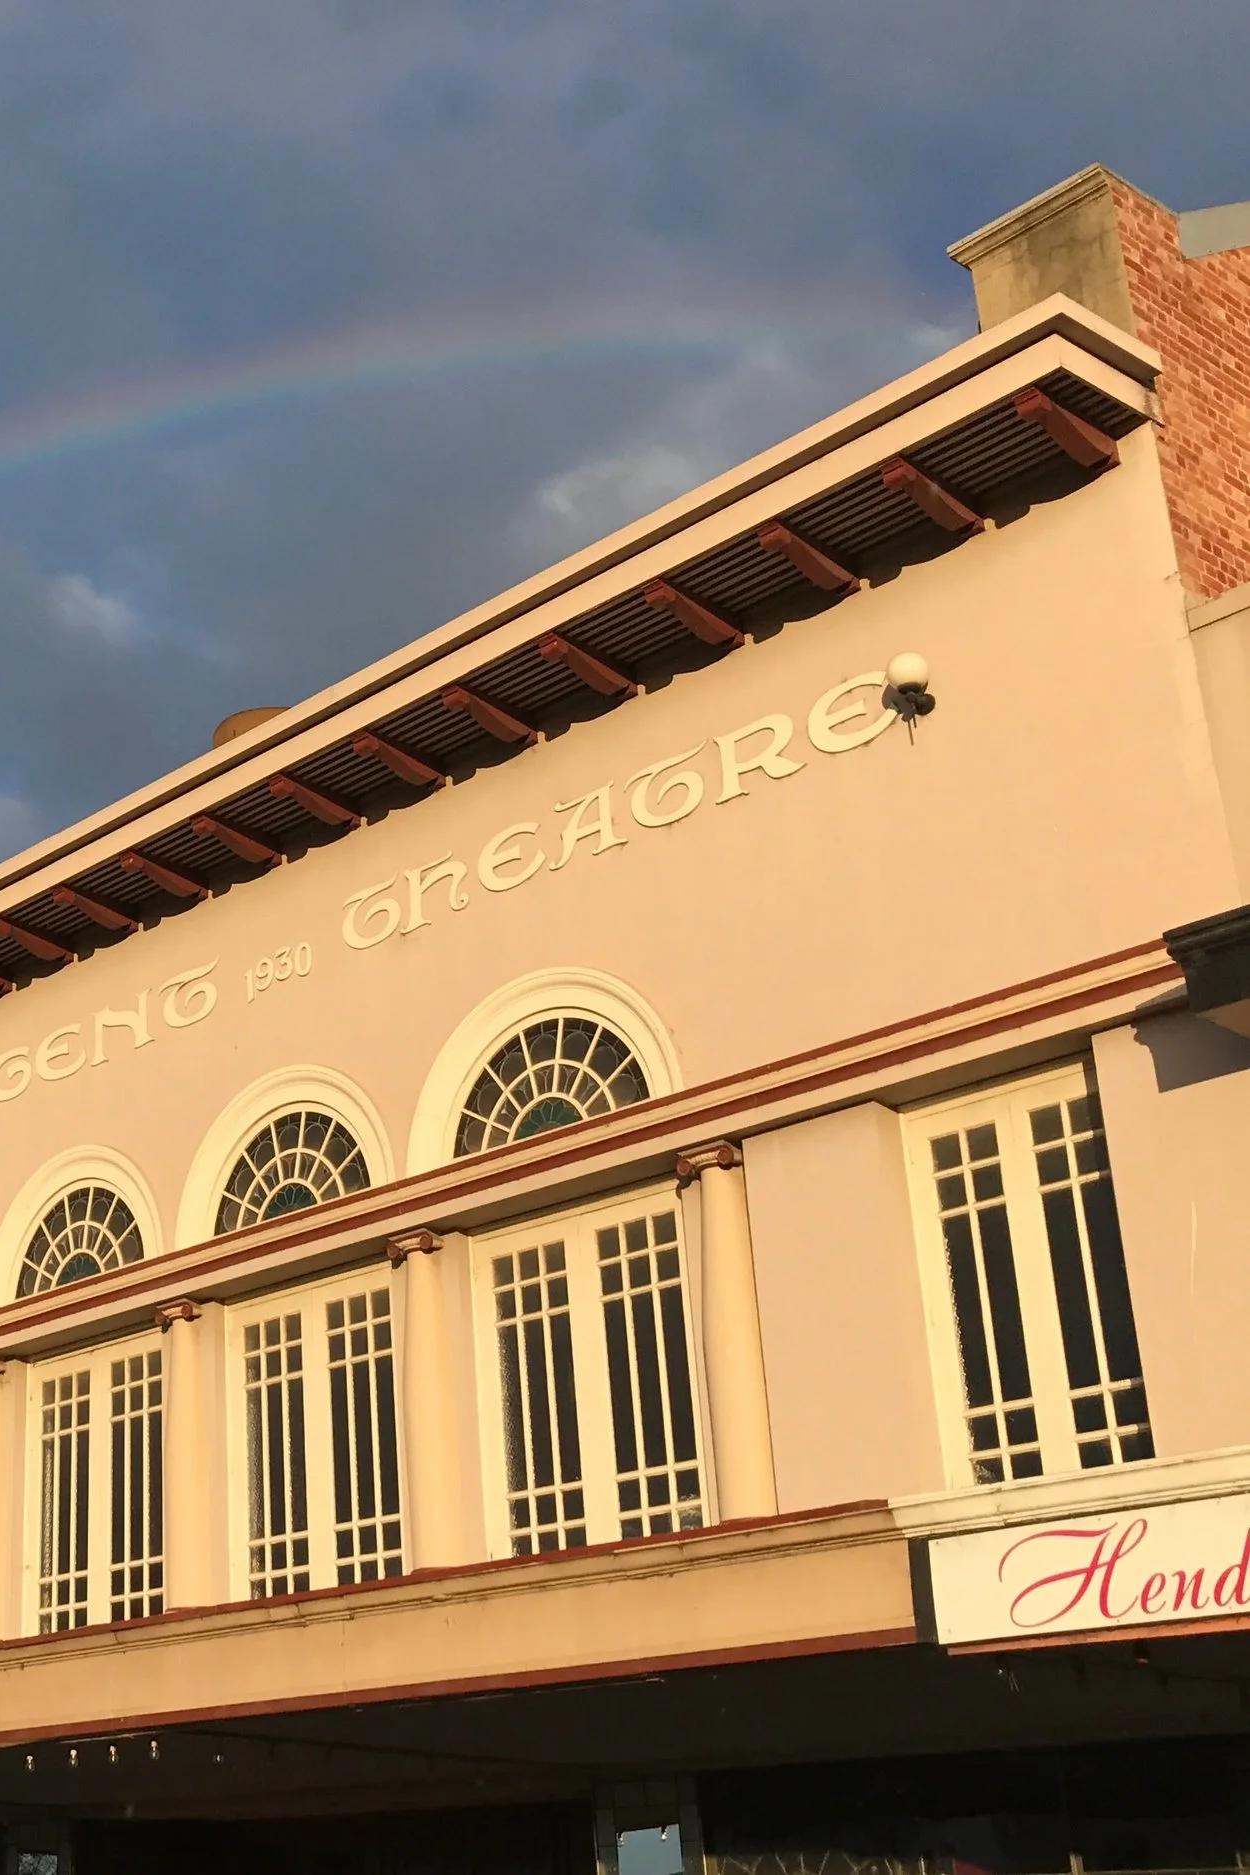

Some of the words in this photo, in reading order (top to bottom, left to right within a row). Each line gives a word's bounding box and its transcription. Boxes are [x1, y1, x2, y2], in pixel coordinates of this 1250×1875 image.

[245, 942, 312, 1003] 1930
[341, 671, 898, 950] THEATRE
[998, 1518, 1250, 1628] Hend
